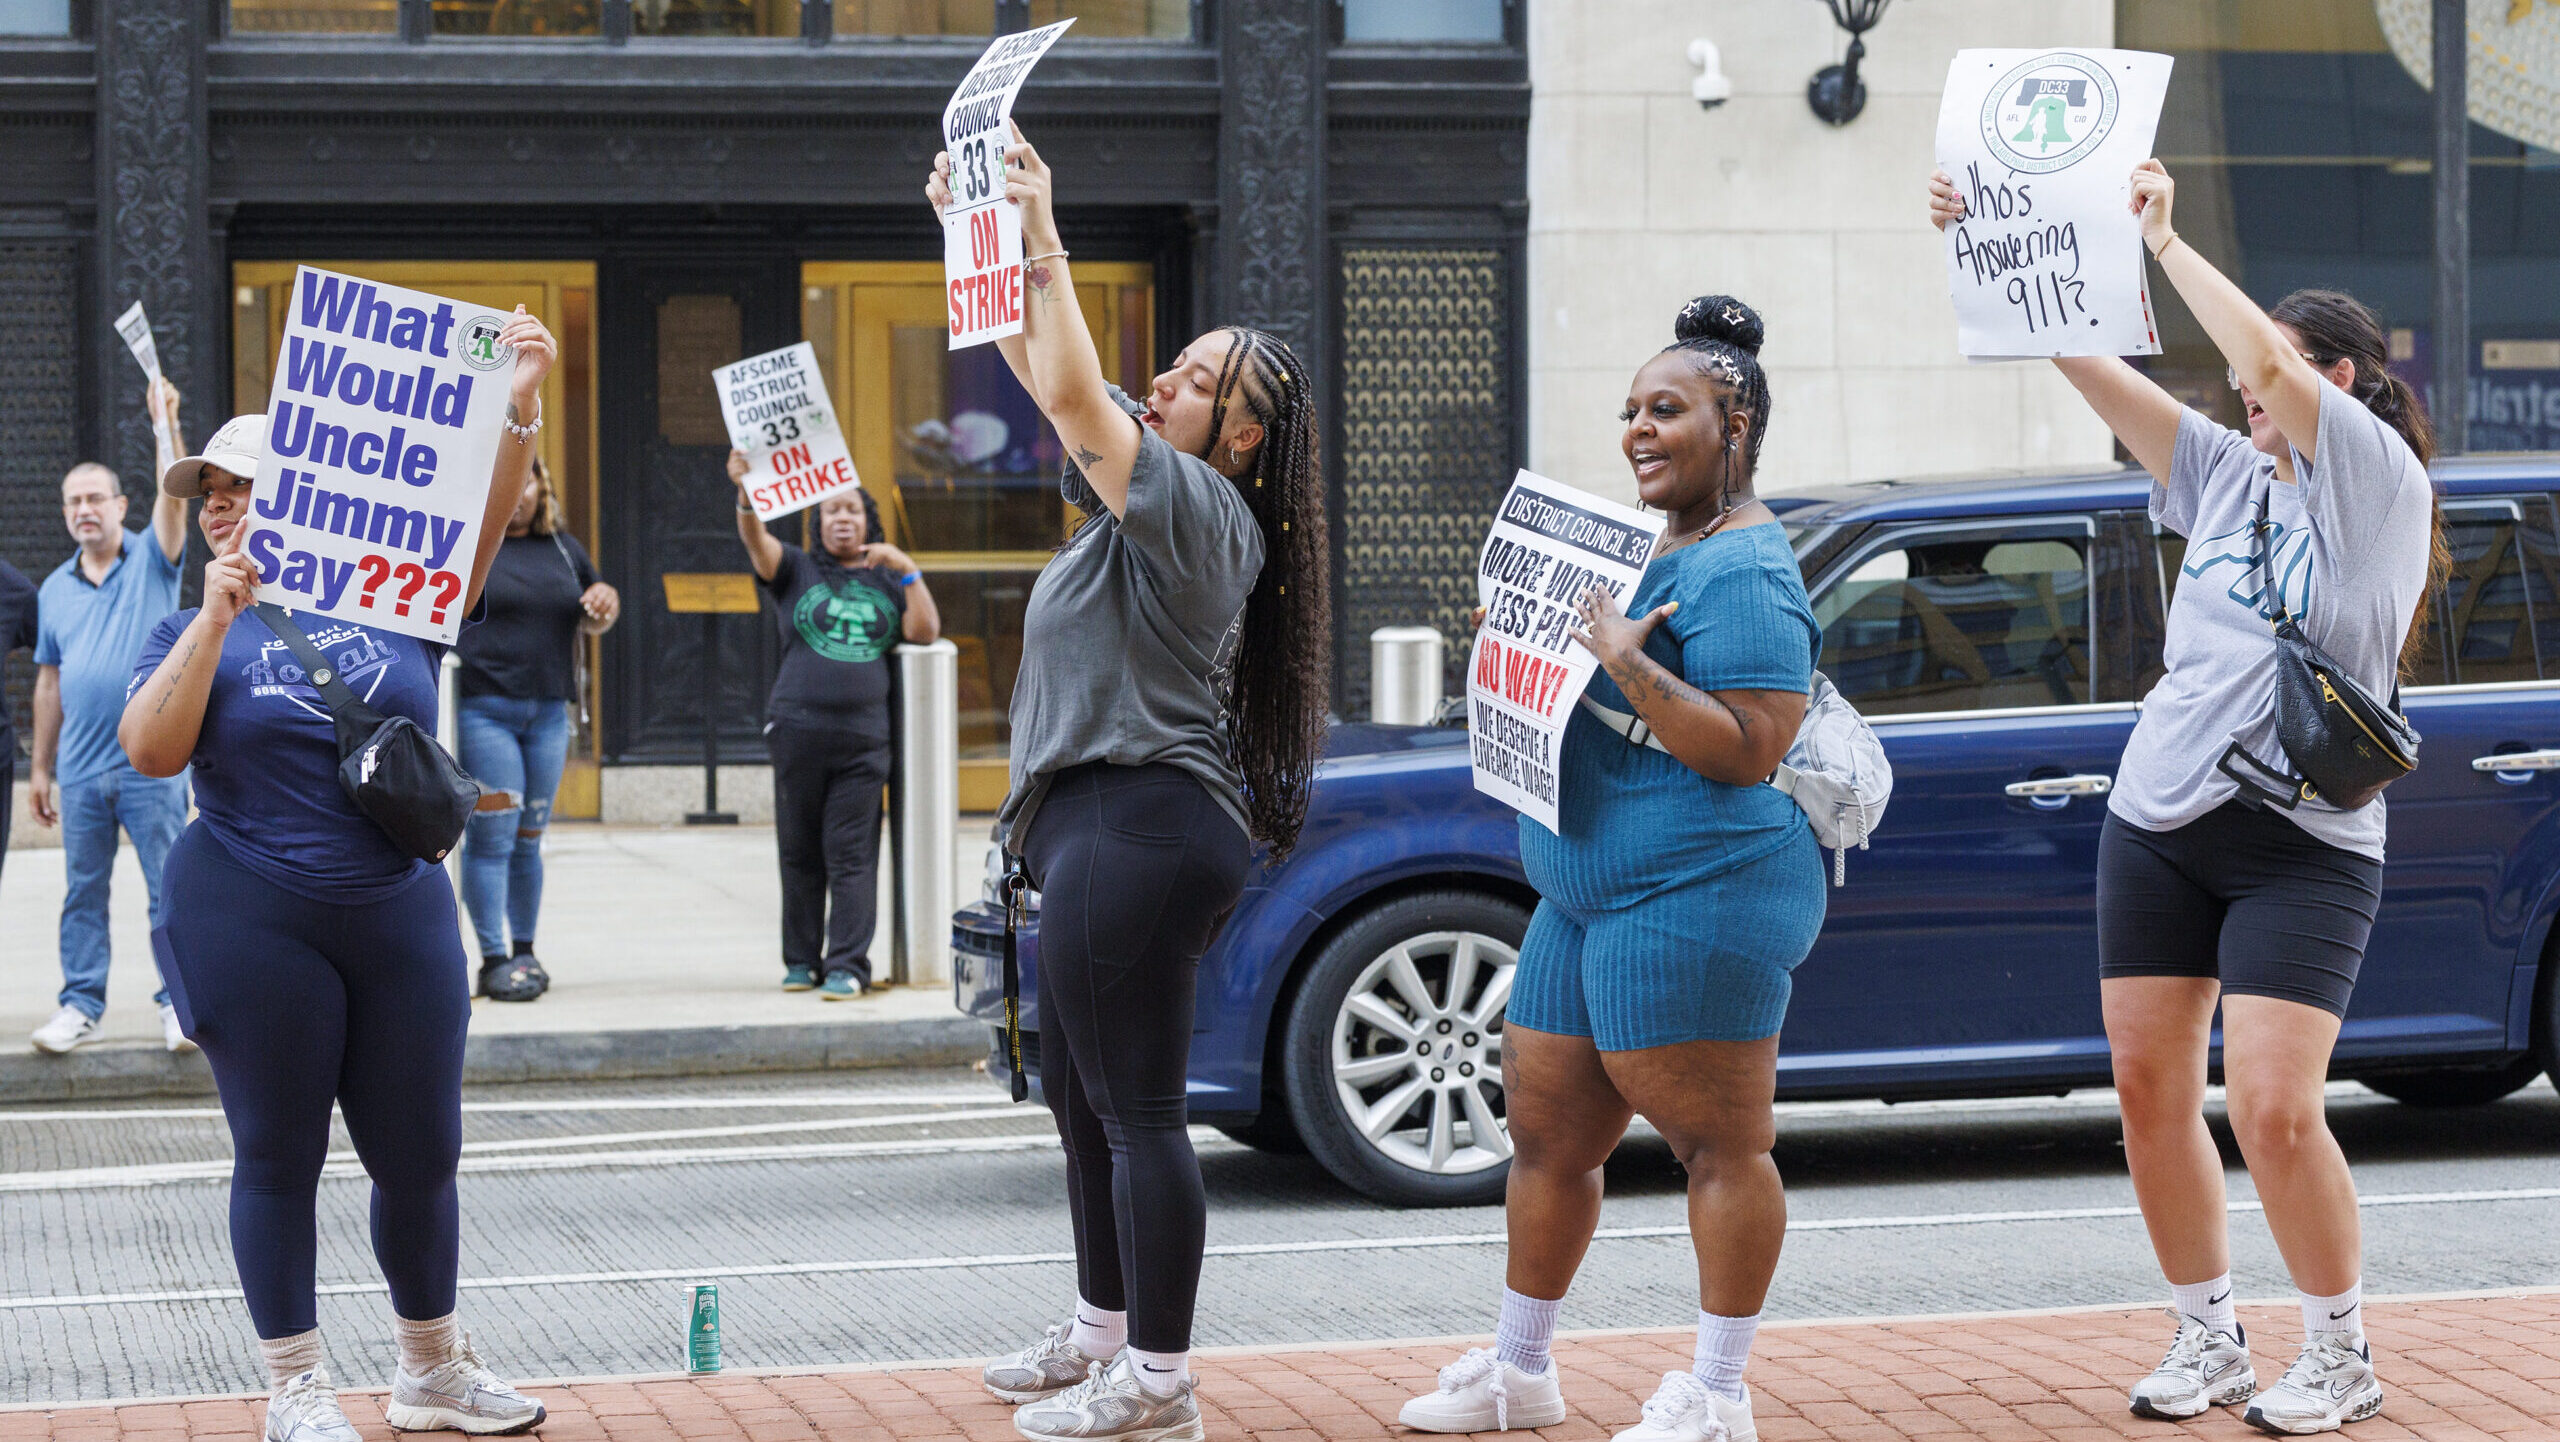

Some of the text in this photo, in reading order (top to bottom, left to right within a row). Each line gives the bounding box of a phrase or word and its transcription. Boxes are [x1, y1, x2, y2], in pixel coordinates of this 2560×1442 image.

[984, 26, 1060, 66] AFSCME
[958, 56, 1034, 101] DISTRICT
[2038, 80, 2070, 94] DC33
[950, 93, 1004, 143] COUNCIL
[2006, 114, 2087, 123] AFL CIO
[963, 138, 990, 201] 33
[970, 207, 999, 271] ON
[1955, 219, 2080, 287] Answering
[302, 271, 455, 358] What
[949, 264, 1021, 337] STRIKE
[2007, 270, 2099, 334] 911?
[287, 336, 473, 429] Would
[730, 351, 799, 386] AFSCME
[731, 370, 807, 406] DISTRICT
[737, 390, 814, 426] COUNCIL
[762, 416, 801, 447] 33
[270, 400, 438, 487] Uncle
[771, 442, 813, 476] ON
[753, 457, 853, 512] STRIKE
[255, 468, 466, 570] Jimmy
[1507, 493, 1575, 536] DISTRICT
[1569, 516, 1628, 558] COUNCIL
[1482, 536, 1553, 593] MORE
[1488, 586, 1584, 655] LESS PAY
[1477, 635, 1569, 717] NO WAY!
[1475, 698, 1550, 768] WE DESERVE A
[1473, 734, 1555, 807] LIVEABLE WAGE!
